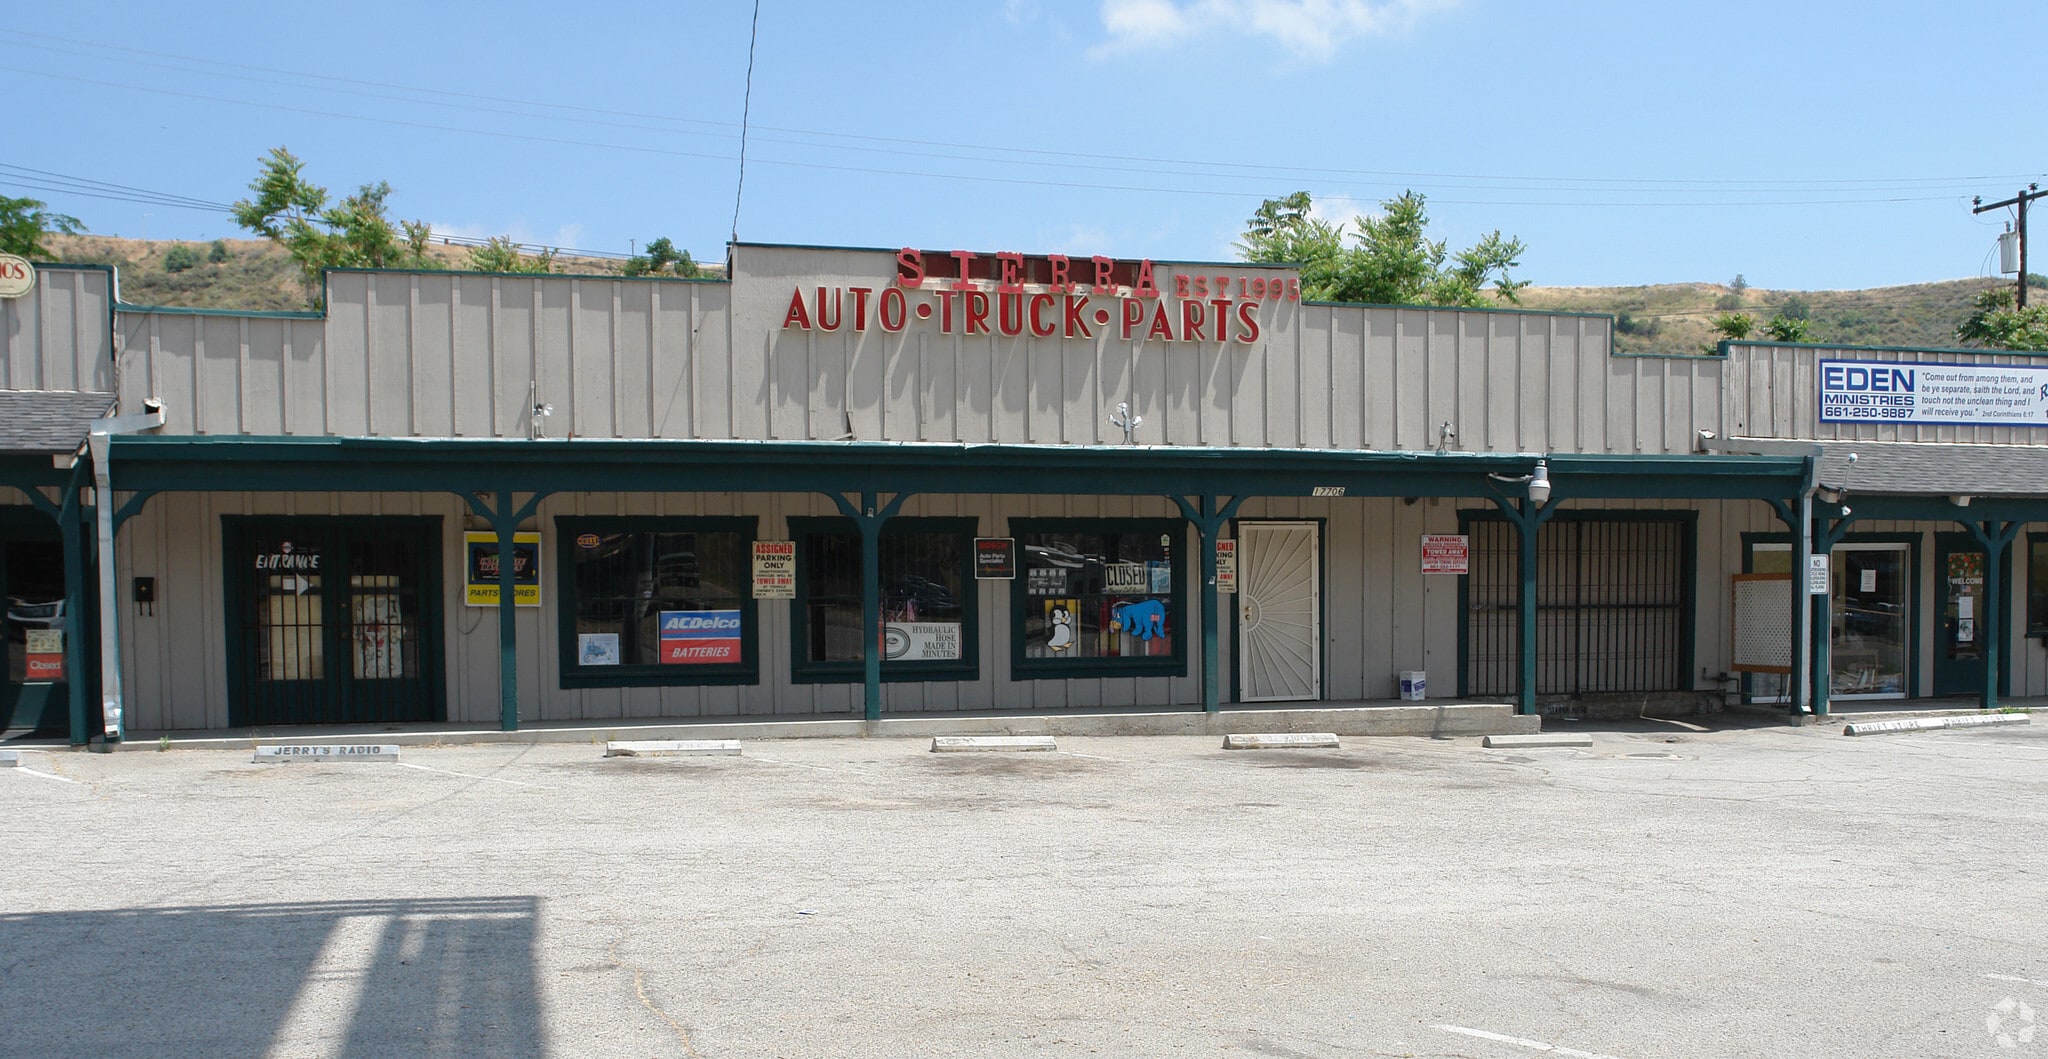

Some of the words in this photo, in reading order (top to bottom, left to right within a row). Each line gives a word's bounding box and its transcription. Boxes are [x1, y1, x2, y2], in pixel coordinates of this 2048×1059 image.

[897, 246, 1160, 298] SIERRA
[1175, 274, 1230, 299] EST
[1239, 276, 1300, 301] 1995
[782, 286, 908, 333] AUTO
[934, 290, 1093, 339] TRUCK
[1119, 297, 1260, 345] PARTS
[1824, 366, 1916, 393] EDEN
[1946, 373, 1958, 382] out
[1958, 373, 1975, 382] from
[1975, 375, 1999, 384] among
[2000, 375, 2019, 384] them,
[2020, 375, 2034, 384] and
[1921, 385, 1931, 393] be
[1931, 386, 1940, 394] ye
[1941, 385, 1972, 395] separate,
[1973, 386, 1990, 394] saith
[1991, 386, 2003, 394] the
[2003, 387, 2021, 395] Lord,
[2022, 387, 2036, 395] and
[1824, 393, 1915, 406] MINISTRIES
[1921, 396, 1941, 404] touch
[1942, 397, 1954, 405] not
[1954, 397, 1966, 405] the
[1967, 397, 1994, 406] unclean
[1995, 398, 2013, 408] thing
[2013, 398, 2027, 406] and
[1825, 406, 1915, 419] 661-250-9887
[1921, 407, 1934, 416] will
[1934, 408, 1959, 417] receive
[1993, 410, 2022, 418] Corinthians
[1314, 487, 1344, 497] 17706
[755, 544, 793, 554] ASSIGNED
[1106, 565, 1146, 586] CLOSED
[470, 589, 499, 597] PARTS
[664, 616, 741, 630] ACDelco
[912, 625, 956, 634] HYDRAULIC
[935, 634, 956, 642] HOSE
[924, 642, 946, 650] MADE
[948, 642, 956, 650] IN
[672, 646, 730, 658] BATTERIES
[922, 650, 956, 658] MINUTES
[30, 660, 61, 669] Closed
[274, 746, 331, 755] JERRY'S
[339, 745, 381, 754] RADIO
